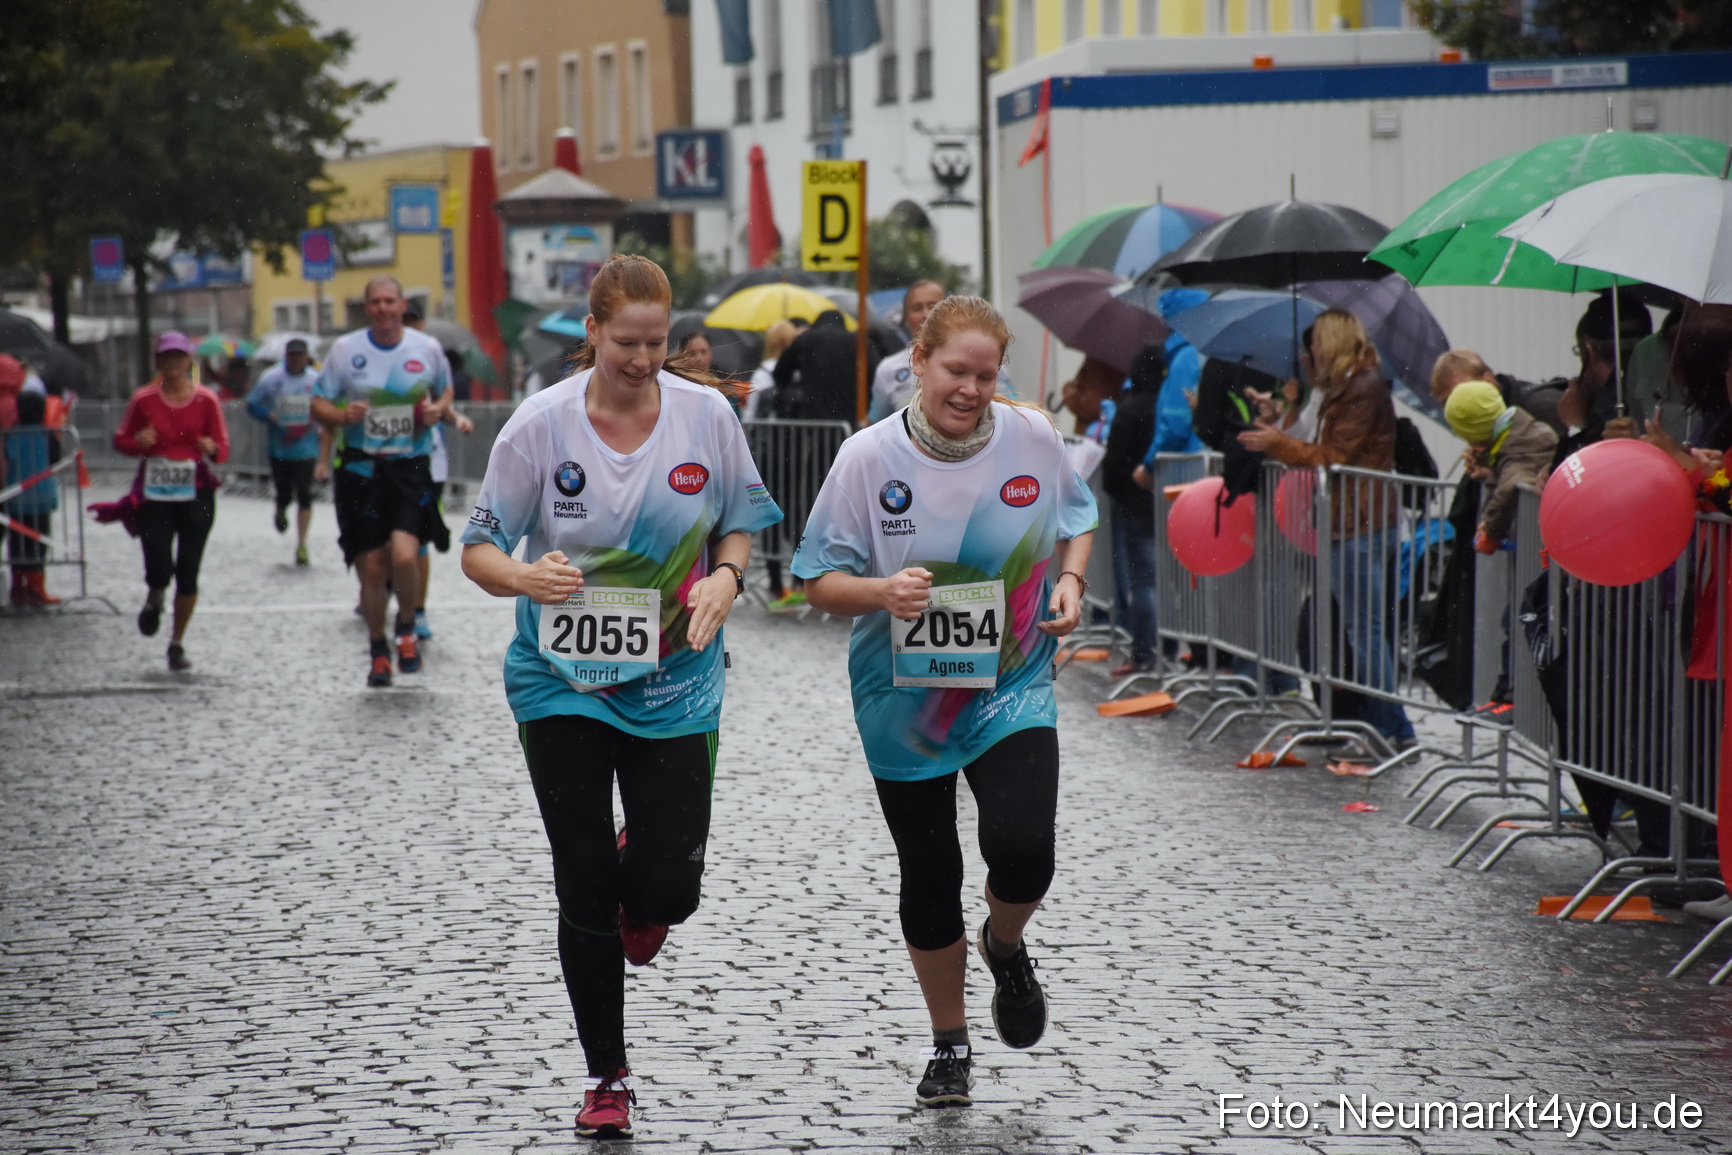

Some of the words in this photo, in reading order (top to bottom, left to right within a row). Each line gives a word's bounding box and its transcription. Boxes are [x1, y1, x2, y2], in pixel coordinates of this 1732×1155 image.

[809, 165, 860, 184] Block
[819, 194, 850, 244] D
[150, 467, 192, 485] 2032
[674, 471, 704, 487] Hervis
[1006, 484, 1037, 499] Hervis
[554, 501, 587, 512] PARTL
[470, 506, 500, 530] BOK
[554, 511, 587, 519] Neumarkt
[881, 519, 916, 529] PARTL
[883, 528, 916, 537] Neumarkt
[592, 591, 650, 606] BOCK
[939, 586, 996, 602] BOCK
[551, 614, 649, 656] 2055
[904, 609, 999, 648] 2054
[575, 666, 619, 683] Ingrid
[929, 659, 975, 677] Agnes
